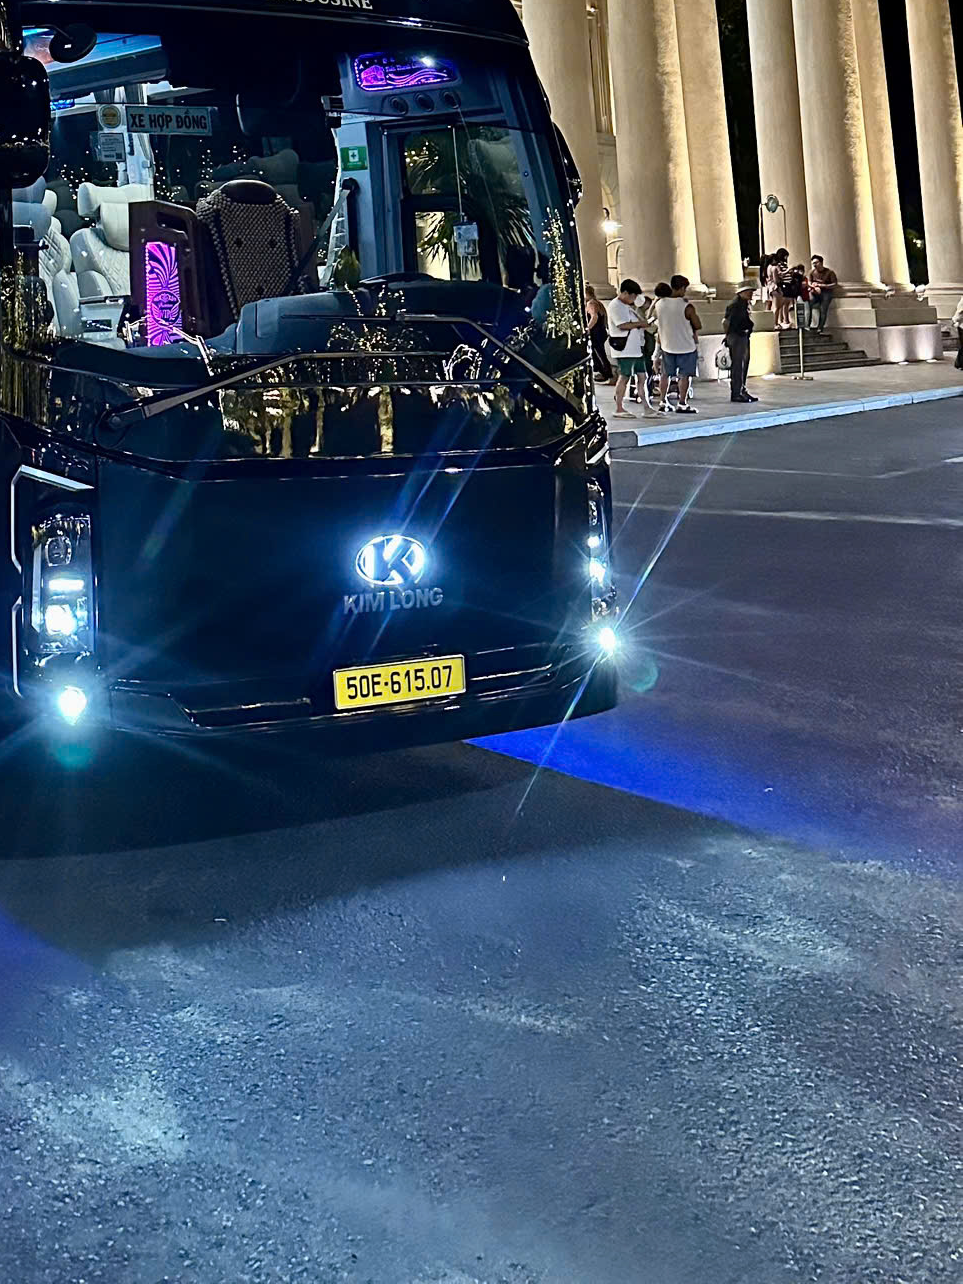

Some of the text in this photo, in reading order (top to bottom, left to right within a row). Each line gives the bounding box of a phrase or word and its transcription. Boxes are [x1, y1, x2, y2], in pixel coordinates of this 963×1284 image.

[130, 113, 145, 128] XE
[149, 112, 173, 131] HỢP
[343, 587, 444, 614] KIM LONG
[346, 664, 453, 700] 50E-615.07
